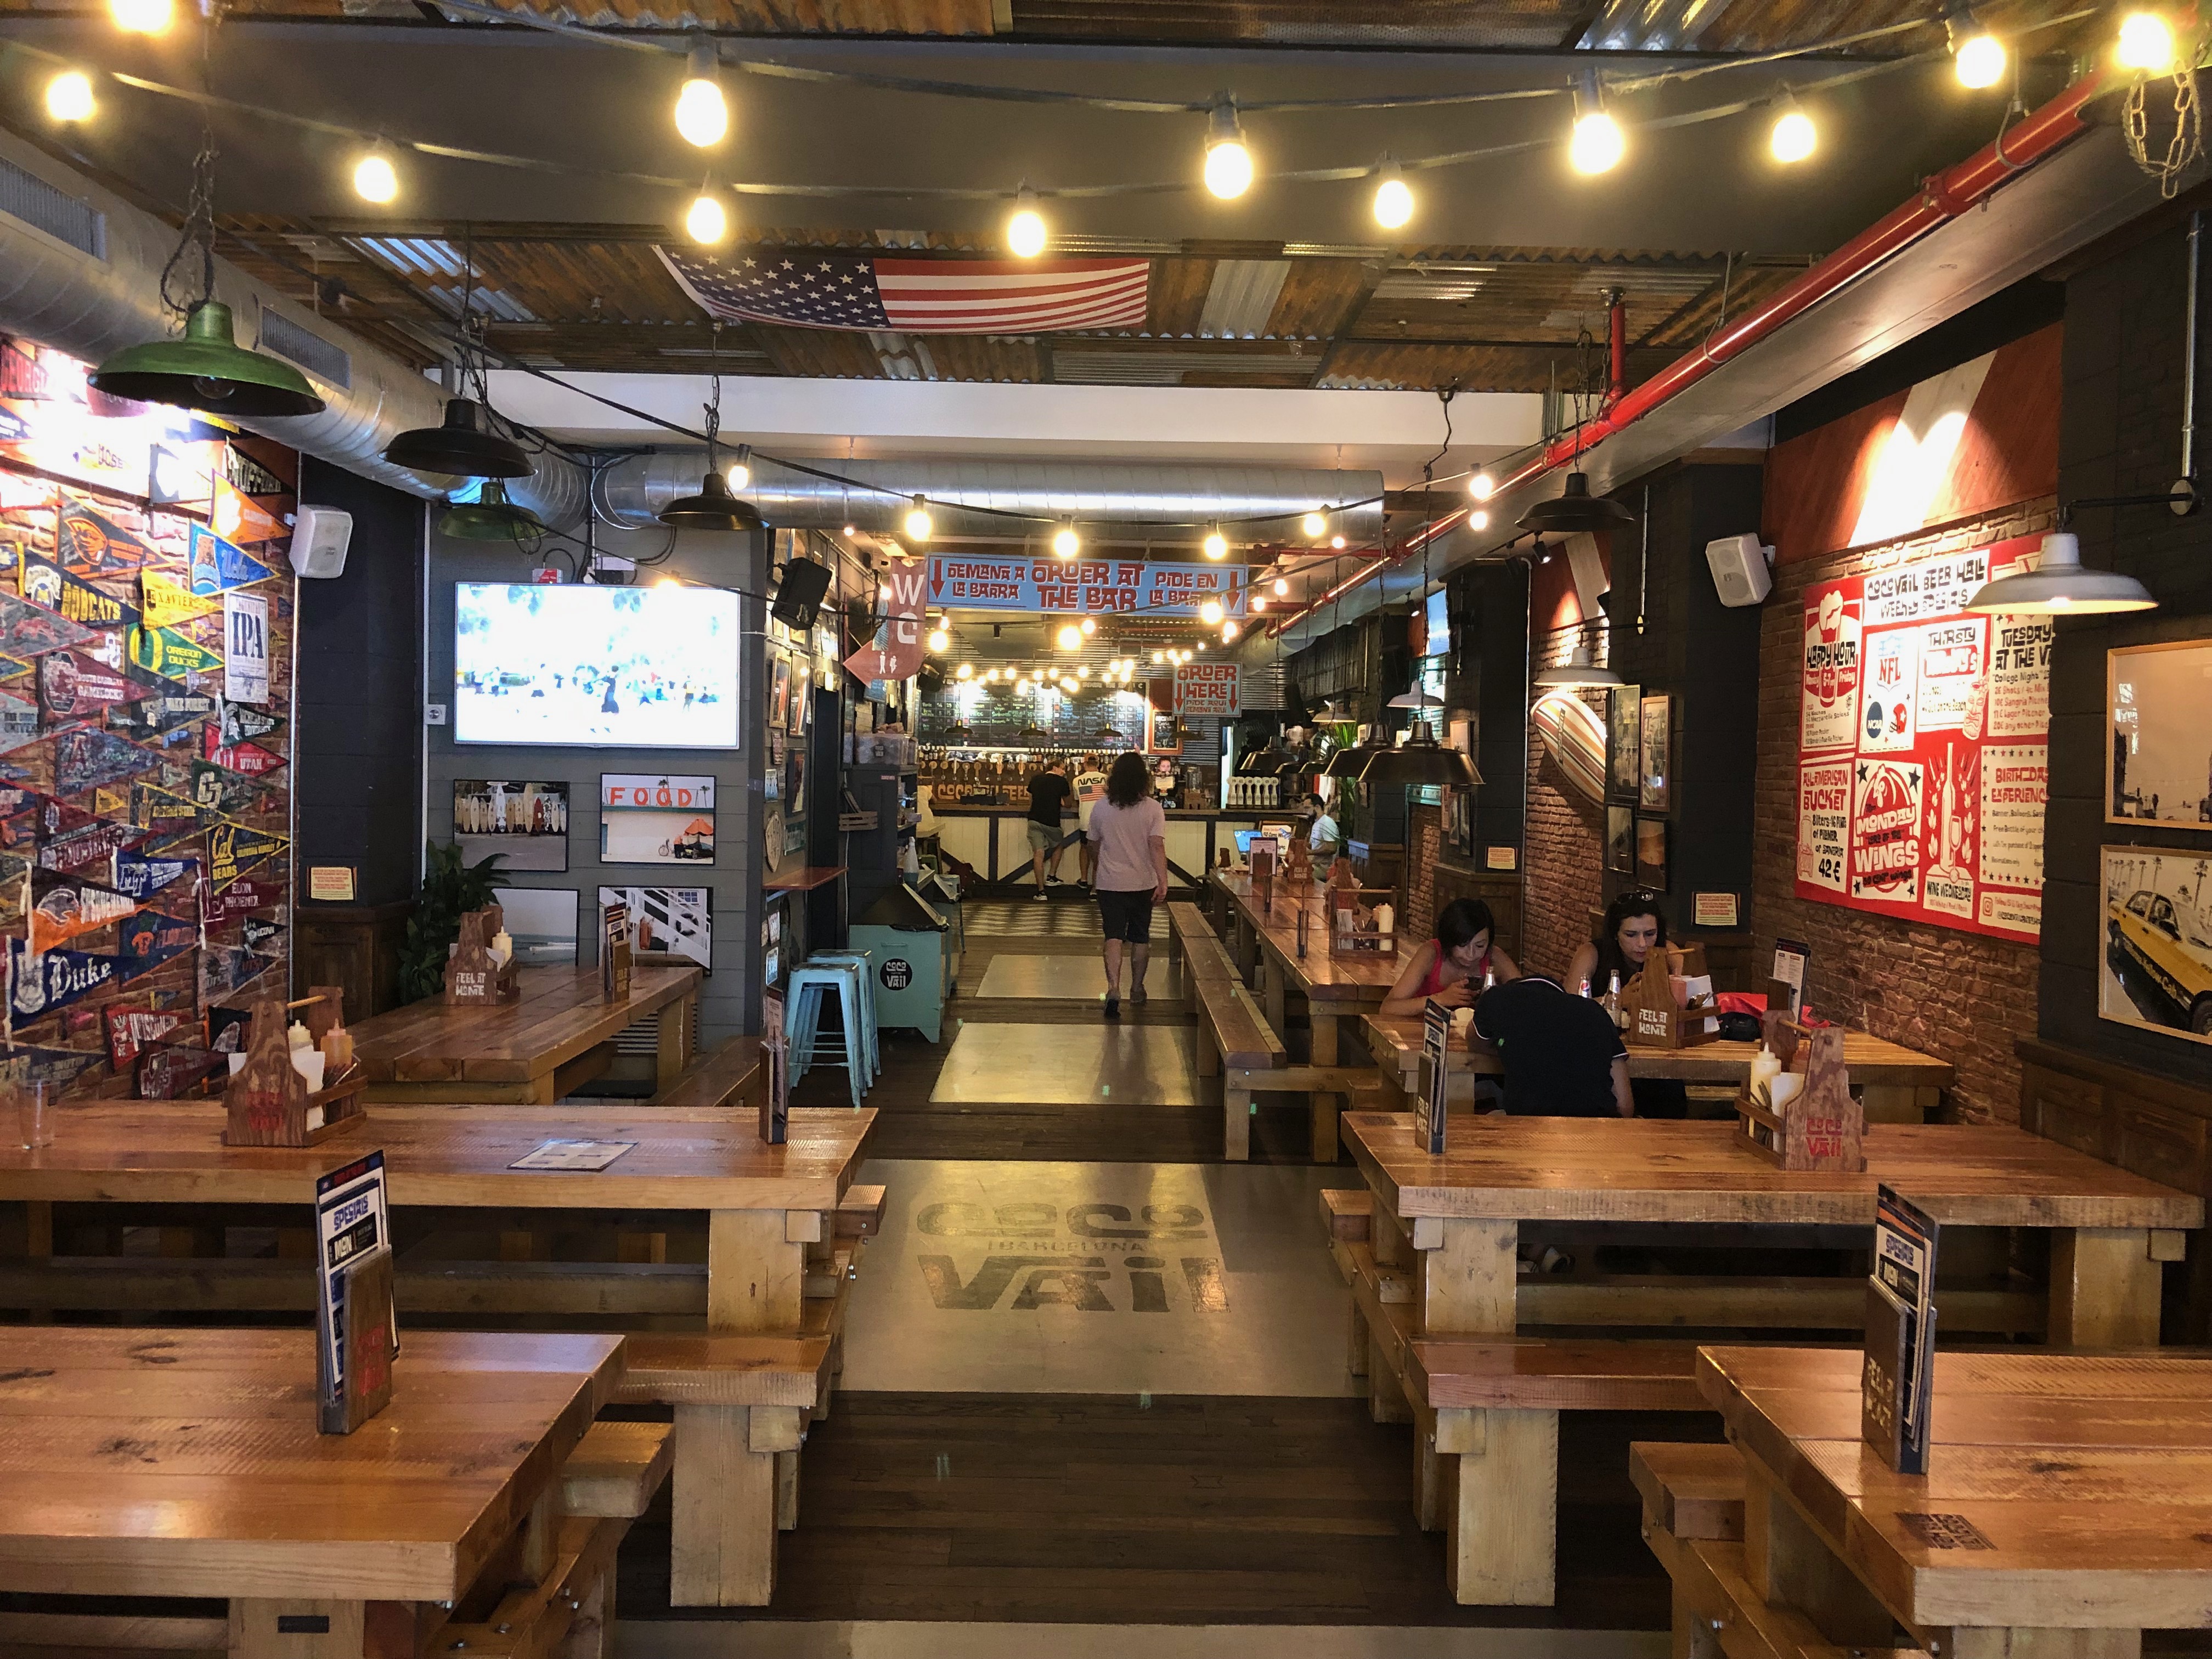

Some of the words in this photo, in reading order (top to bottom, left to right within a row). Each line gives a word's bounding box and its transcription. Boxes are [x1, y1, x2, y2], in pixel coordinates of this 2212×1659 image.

[947, 562, 1011, 581] DEMANA
[1015, 566, 1026, 582] A
[1031, 560, 1110, 585] ORDER
[1117, 563, 1146, 587] AT
[1155, 571, 1193, 588] PIDE
[1197, 573, 1218, 589] EN
[1924, 566, 1951, 590] BEER
[1957, 558, 1985, 583] HALL
[159, 591, 196, 607] XAVIER
[952, 582, 966, 597] LA
[969, 583, 1019, 600] BARRA
[1037, 585, 1079, 609] THE
[1085, 588, 1137, 611] BAR
[1149, 589, 1164, 606] LA
[61, 580, 121, 622] BOBCATS
[232, 611, 264, 659] IPA
[166, 645, 202, 658] OREGON
[1807, 643, 1832, 669] HAPPY
[1834, 641, 1856, 666] HOUR
[1995, 648, 2010, 670] AT
[2013, 647, 2035, 669] THE
[168, 656, 200, 668] DUCKS
[1177, 665, 1237, 681] ORDER
[1839, 669, 1856, 685] Friday
[1879, 657, 1901, 685] NFL
[1186, 683, 1227, 699] HERE
[240, 758, 262, 770] UTAH
[1078, 777, 1106, 785] NASA
[610, 786, 693, 809] FOOD
[1803, 789, 1847, 811] BUCKET
[1991, 788, 2049, 804] EXPERIENC
[1857, 806, 1915, 835] MONDAY
[213, 865, 237, 881] BEARS
[232, 883, 251, 894] ELON
[886, 962, 906, 972] COCO
[48, 955, 112, 1002] Duke
[456, 973, 475, 984] FEEL
[477, 973, 487, 984] AT
[455, 985, 485, 996] HOME
[1639, 1008, 1657, 1023] FEEL
[1659, 1011, 1668, 1023] AT
[1639, 1022, 1667, 1037] HOME
[1806, 1118, 1842, 1136] COCO
[333, 1194, 369, 1232] SPECIALS
[917, 1203, 1208, 1239] COCO
[998, 1240, 1146, 1254] BARCELONA
